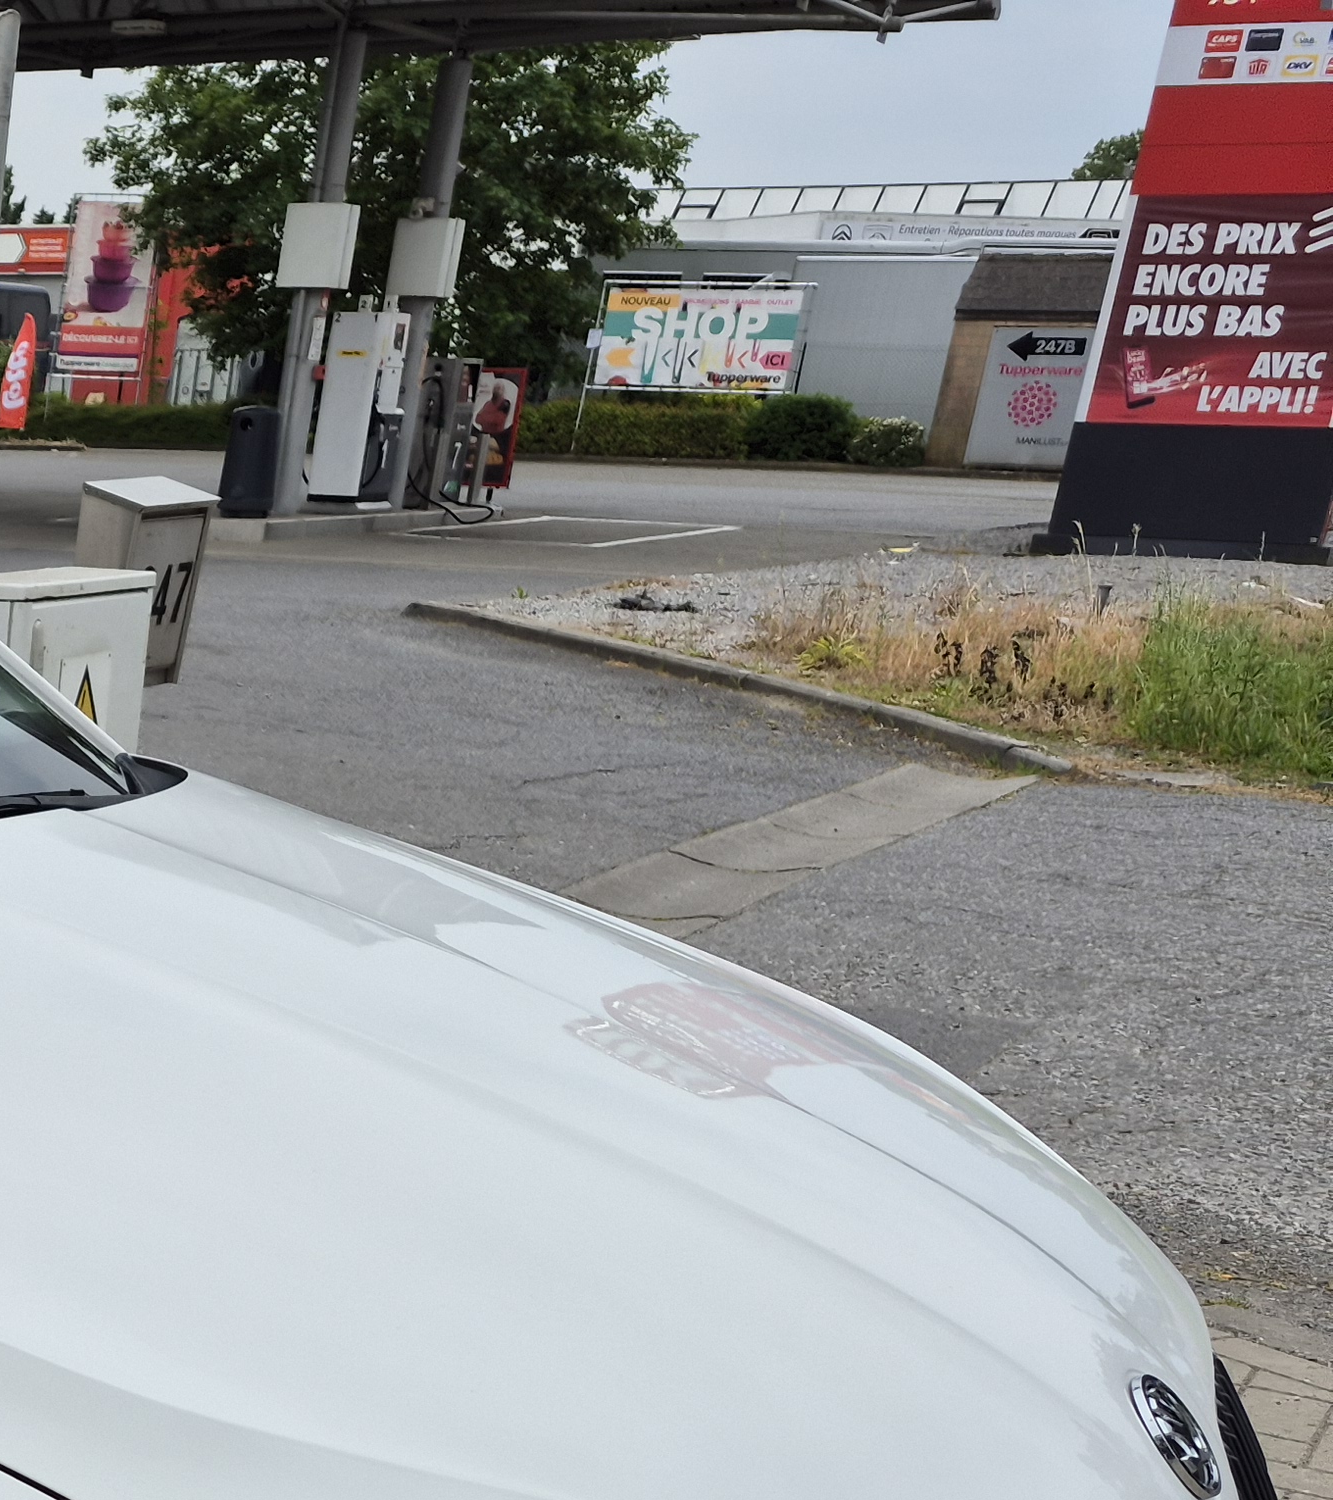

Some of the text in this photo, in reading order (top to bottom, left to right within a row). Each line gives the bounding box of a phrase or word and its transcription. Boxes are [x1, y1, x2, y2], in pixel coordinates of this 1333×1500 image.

[898, 224, 940, 235] Entretien
[947, 225, 1003, 237] Réparations
[1005, 228, 1034, 238] toutes
[1141, 222, 1302, 255] DES PRIX
[1132, 264, 1271, 296] ENCORE
[620, 296, 671, 305] NOUVEAU
[631, 306, 769, 341] SHOP
[1123, 305, 1285, 337] PLUS BAS
[765, 354, 786, 366] ICI
[999, 363, 1083, 377] Tupperware
[1248, 351, 1327, 380] AVEC
[706, 371, 781, 384] Tupperware
[145, 560, 194, 626] 47
